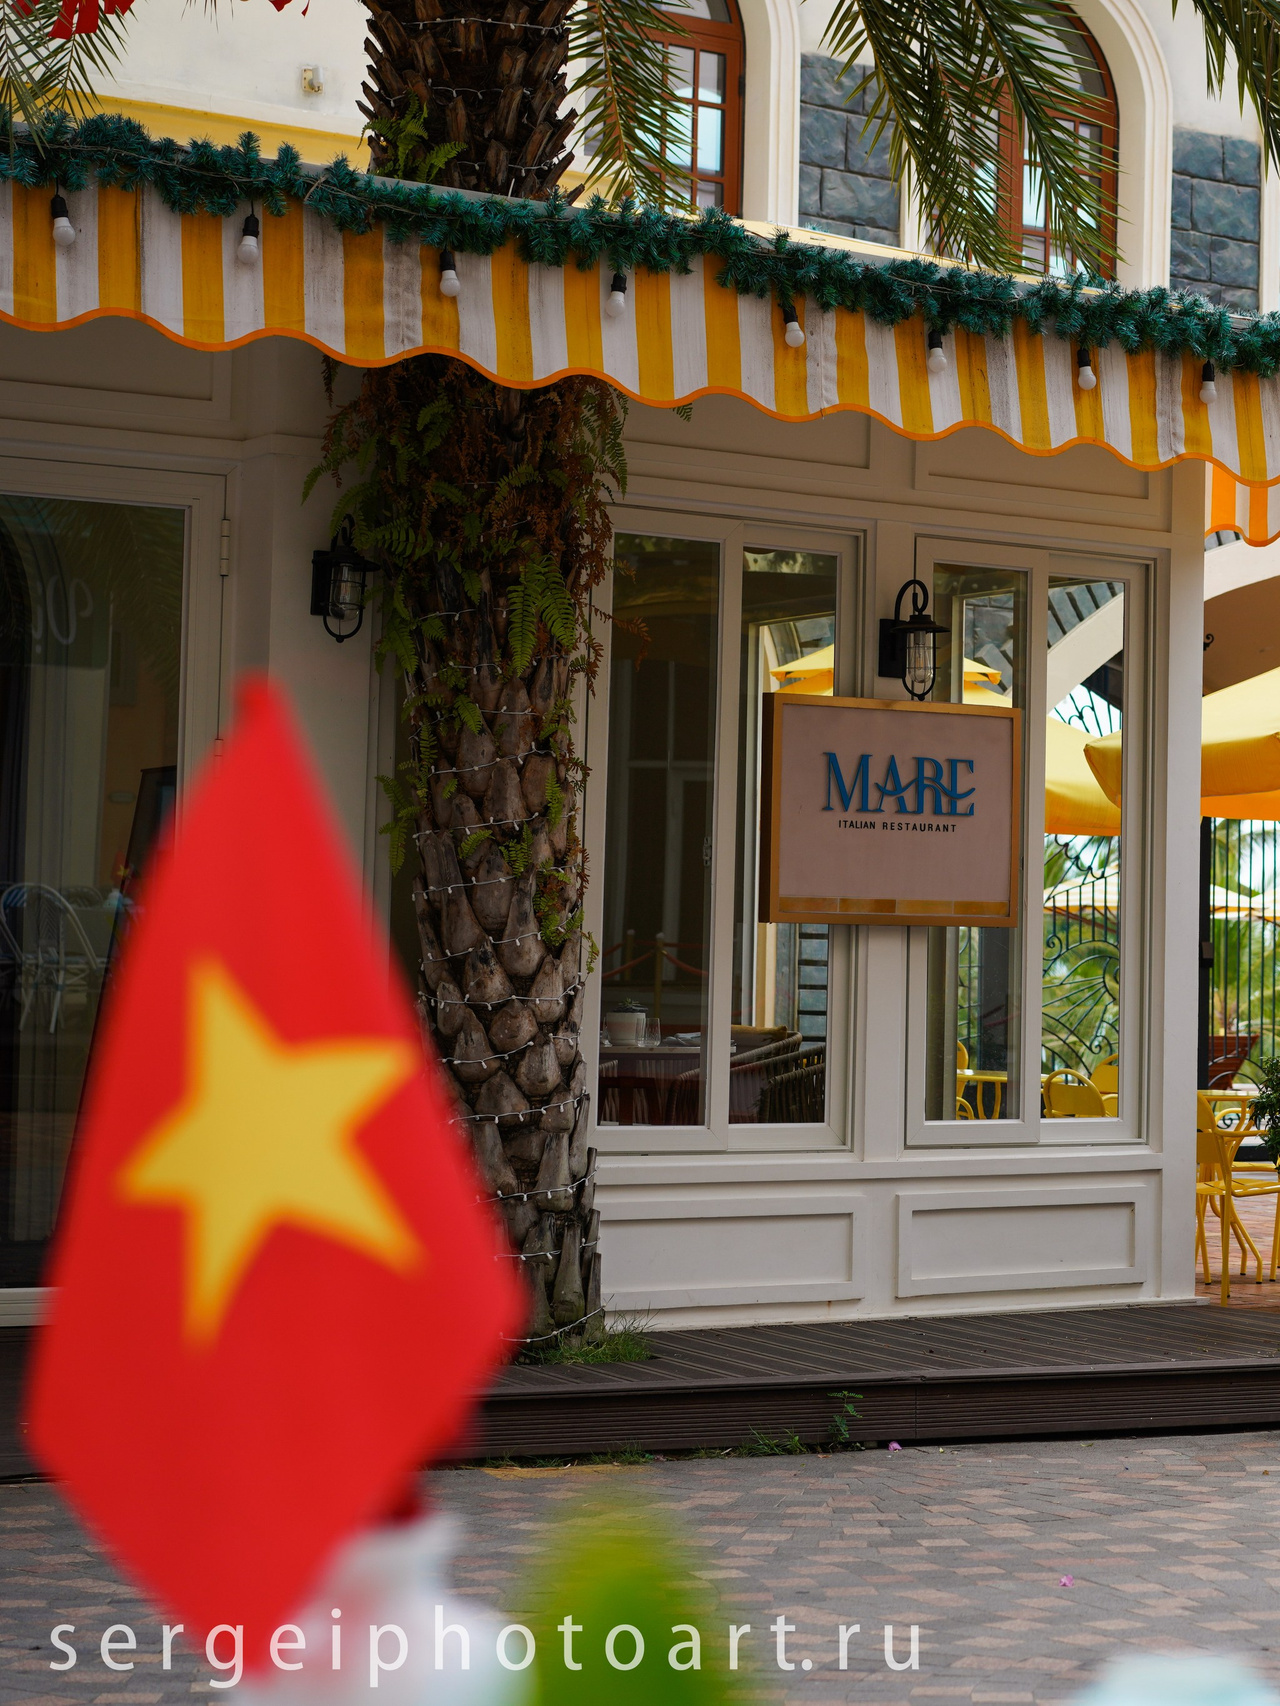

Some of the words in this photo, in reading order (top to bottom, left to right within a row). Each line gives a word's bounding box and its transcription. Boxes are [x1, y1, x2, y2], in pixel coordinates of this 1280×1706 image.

[822, 752, 976, 816] MARE
[838, 820, 876, 830] ITALIAN
[882, 821, 957, 833] RESTAURANT
